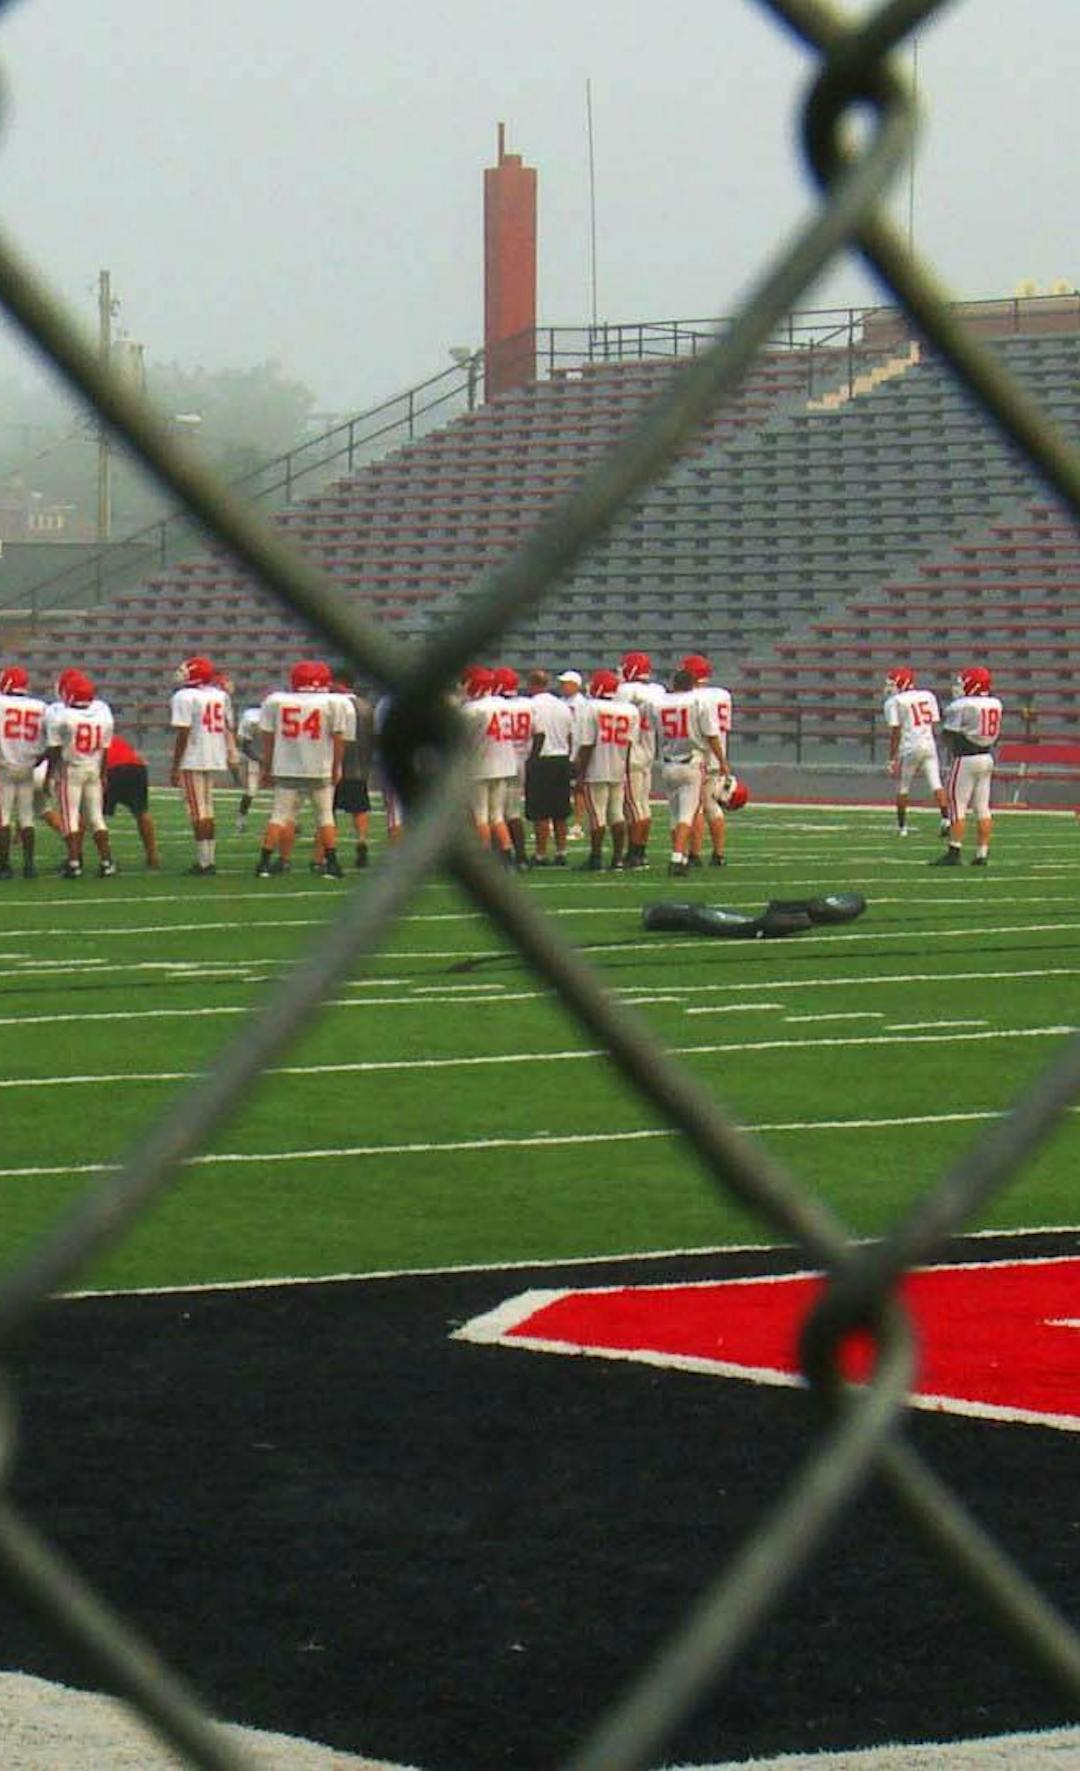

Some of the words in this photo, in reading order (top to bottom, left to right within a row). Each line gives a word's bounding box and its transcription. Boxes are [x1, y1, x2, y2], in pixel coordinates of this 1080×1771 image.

[4, 708, 41, 741] 25
[281, 706, 321, 740] 54
[661, 708, 690, 738] 51
[911, 701, 933, 726] 15
[980, 707, 999, 737] 18
[75, 723, 101, 754] 81
[600, 713, 630, 746] 52
